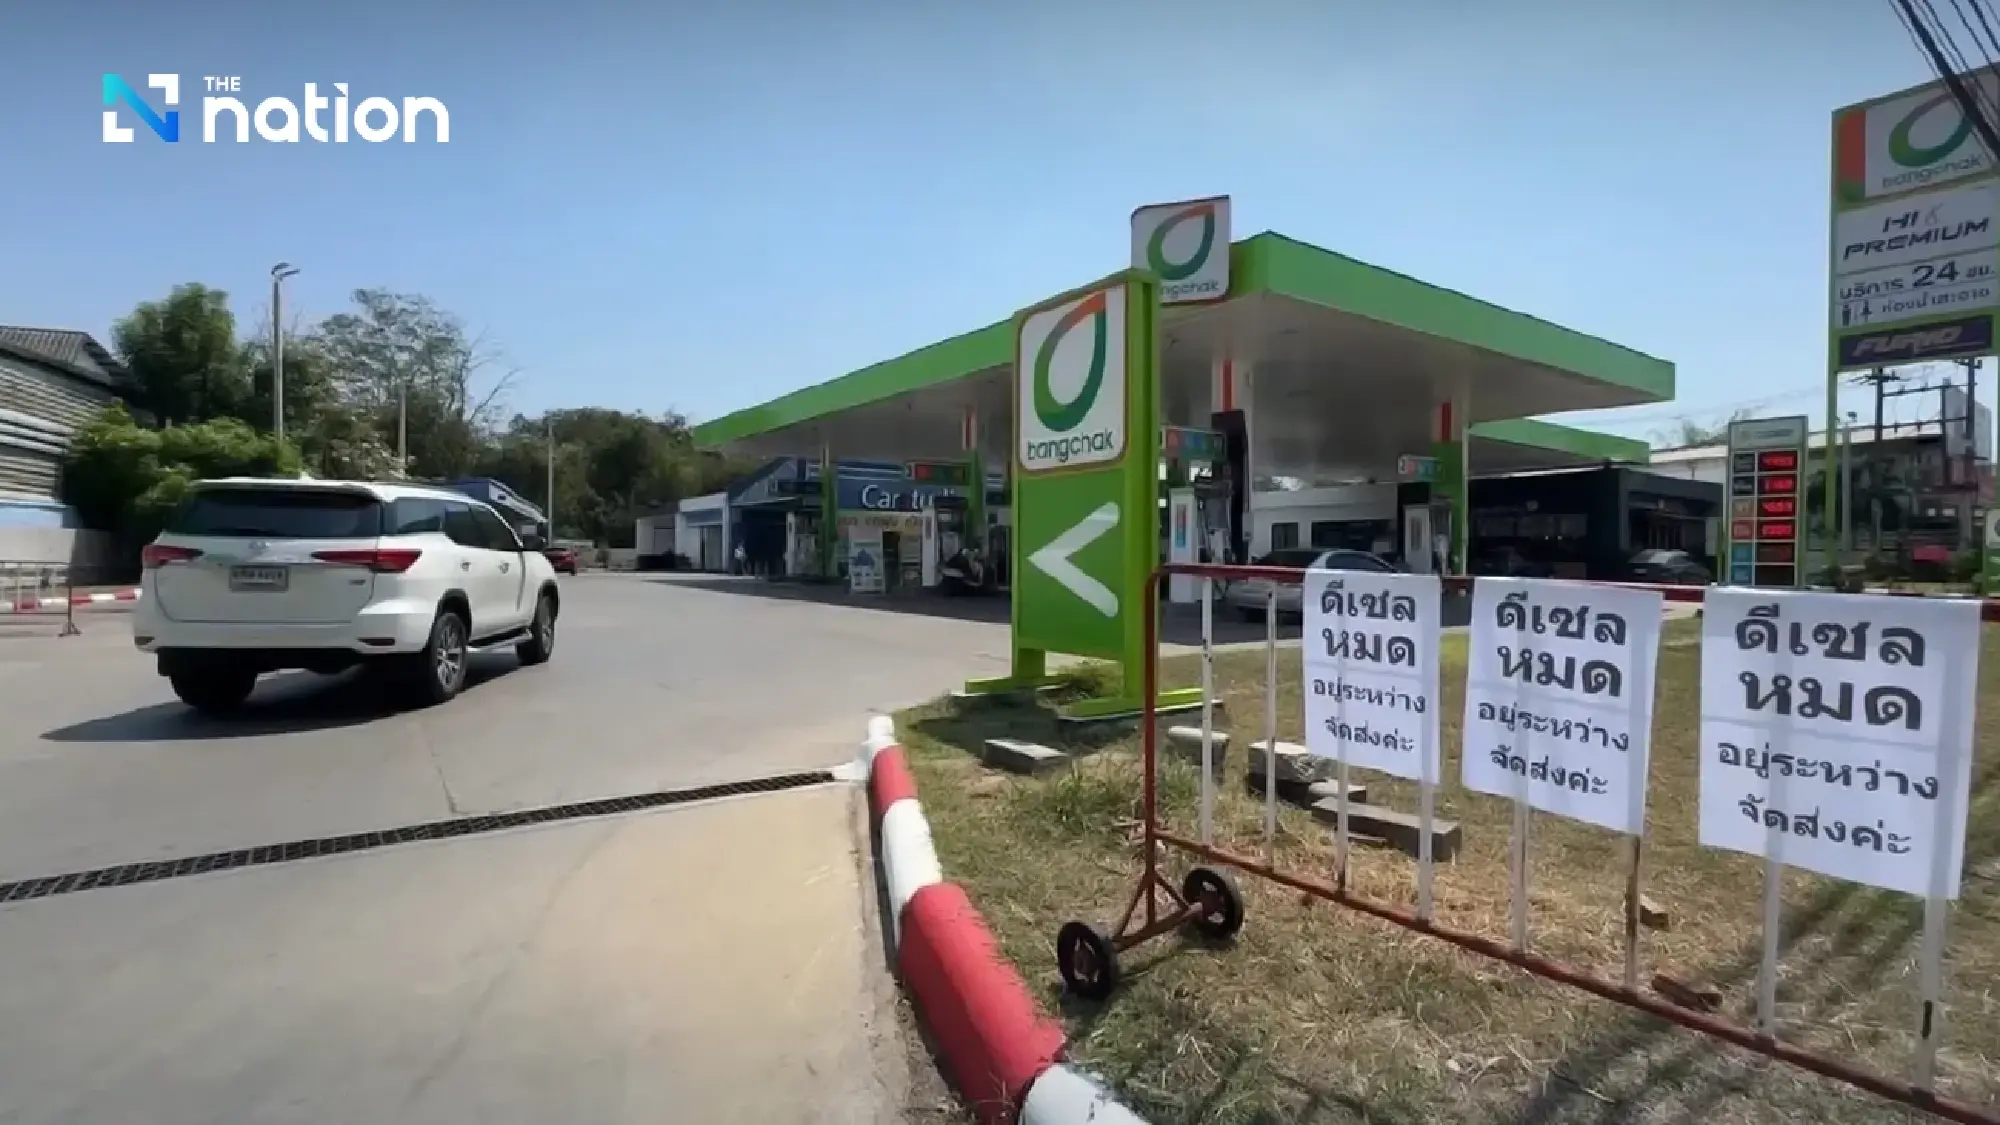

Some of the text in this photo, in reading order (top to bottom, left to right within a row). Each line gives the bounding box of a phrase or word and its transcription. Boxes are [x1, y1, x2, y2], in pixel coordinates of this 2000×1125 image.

[1843, 217, 1990, 260] PREMIUM
[1883, 209, 1920, 233] HI
[1161, 279, 1219, 299] ngchak
[1912, 260, 1960, 289] 24
[1027, 428, 1114, 463] bangchak
[862, 484, 900, 509] Car
[1322, 627, 1415, 667] หมด
[1497, 646, 1622, 697] หมด
[1313, 676, 1426, 714] อยู่ระหว่าง
[1738, 671, 1922, 731] หมด
[1325, 715, 1415, 752] จัดส่งค่ะ
[1478, 702, 1629, 752] อยู่ระหว่าง
[1490, 744, 1608, 795] จัดส่งค่ะ
[1718, 742, 1939, 800] อยู่ระหว่าง
[1738, 794, 1911, 855] จัดส่งค่ะ
